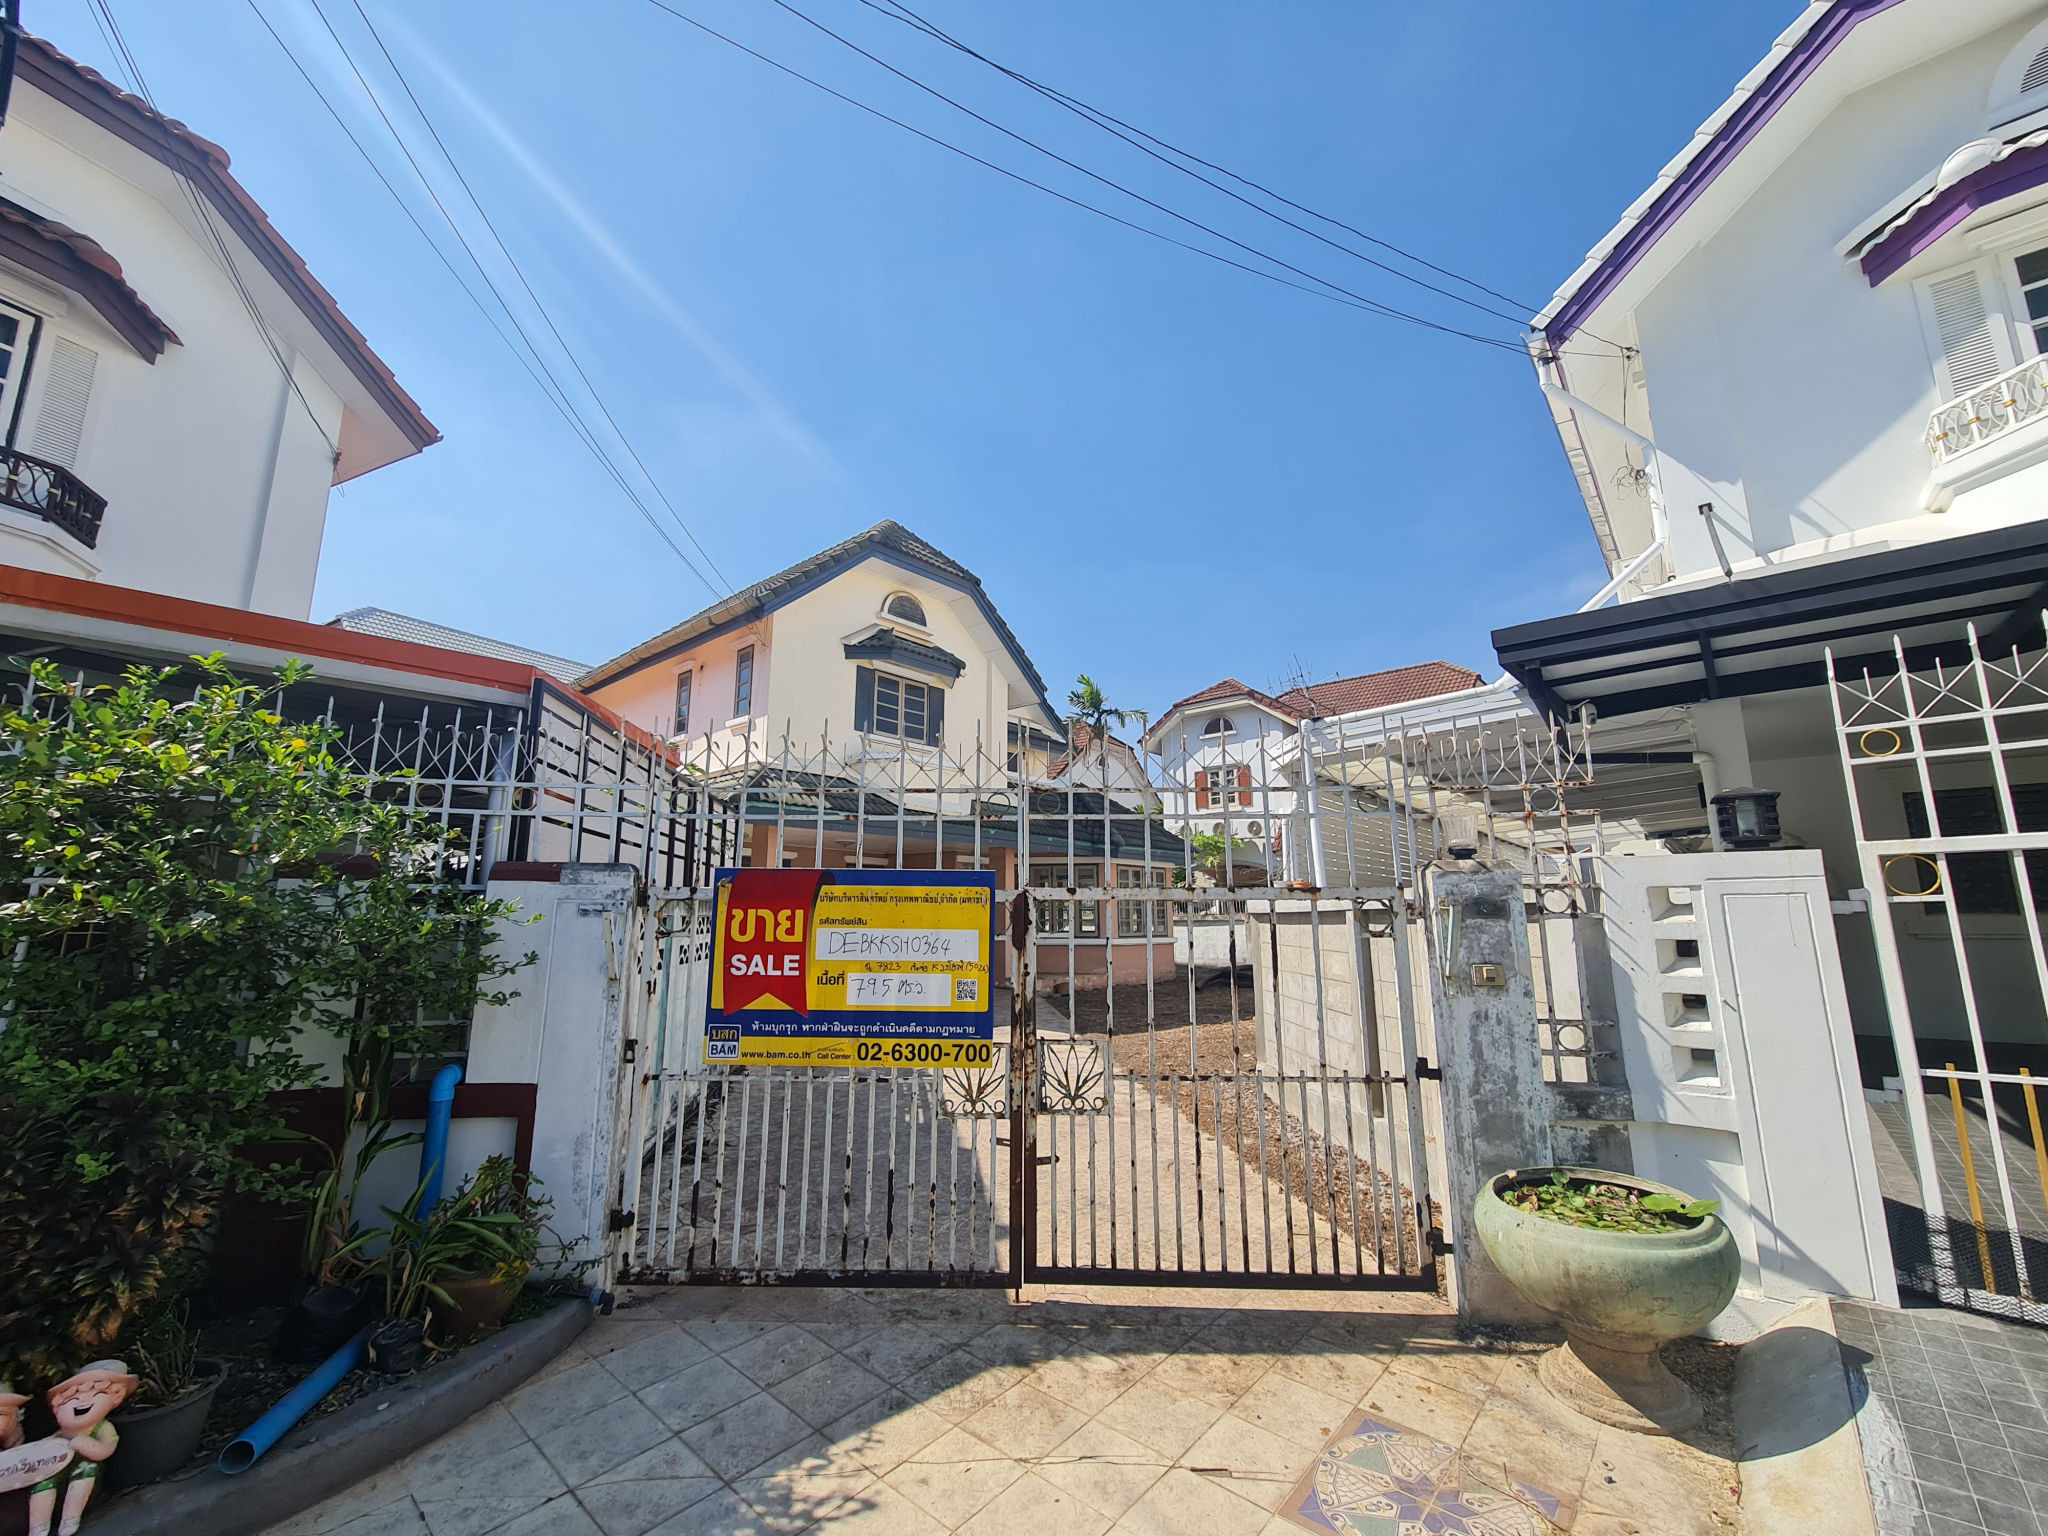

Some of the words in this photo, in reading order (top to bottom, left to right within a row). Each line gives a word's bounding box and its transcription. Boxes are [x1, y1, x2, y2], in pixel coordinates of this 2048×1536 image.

[730, 908, 804, 943] ขาย
[730, 954, 800, 976] SALE
[816, 969, 845, 985] เนื้อที่
[711, 1029, 737, 1040] บสก
[751, 1020, 798, 1036] ห้ามบุกรุก
[711, 1043, 737, 1056] BAM
[741, 1050, 811, 1060] www.bam.co.th
[817, 1052, 829, 1060] Call
[857, 1042, 990, 1063] 02-6300-700
